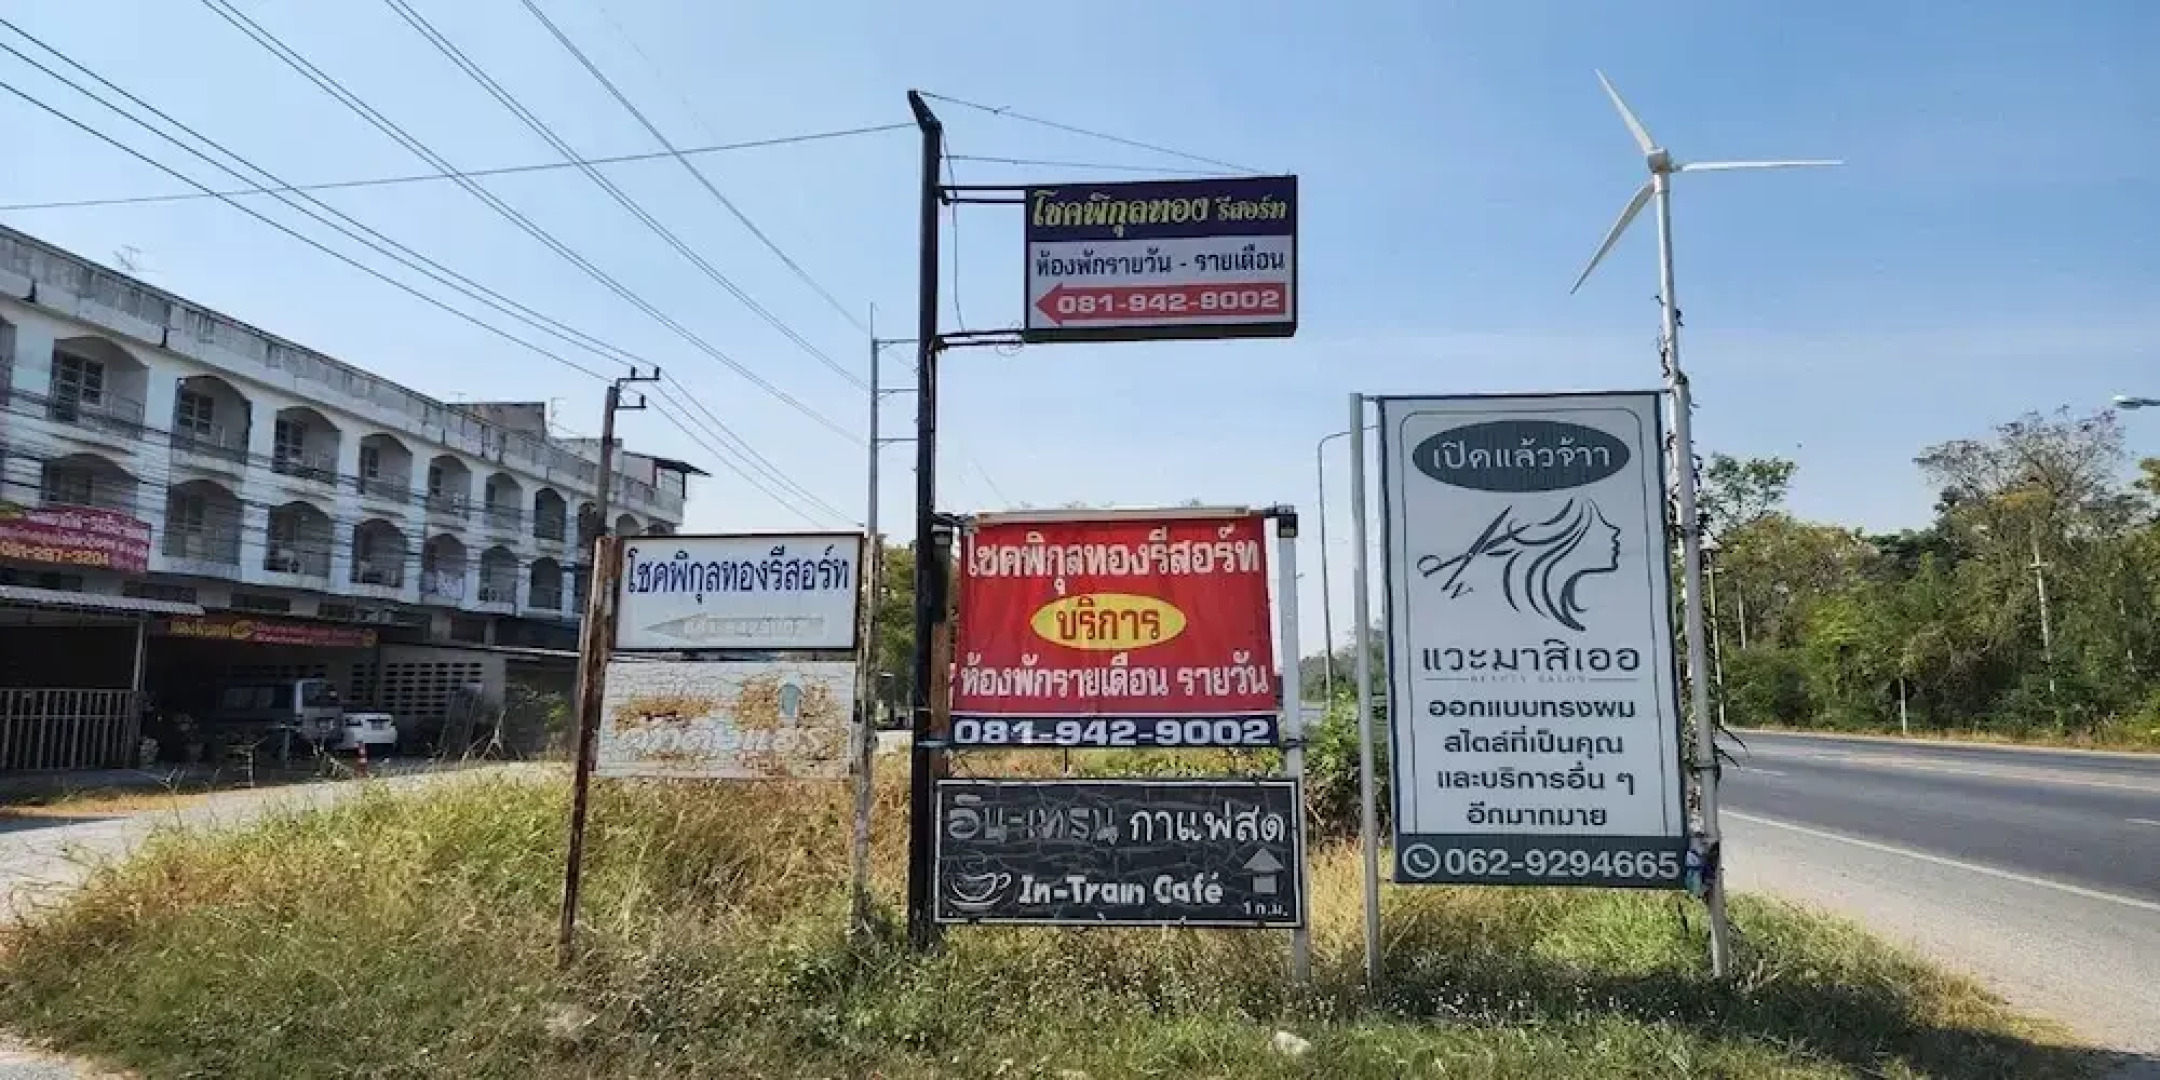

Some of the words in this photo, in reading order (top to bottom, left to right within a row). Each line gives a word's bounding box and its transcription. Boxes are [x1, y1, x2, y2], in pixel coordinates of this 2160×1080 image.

[1032, 189, 1211, 238] โชคพิกุลทอง
[1216, 194, 1287, 222] รีสอร์ท
[1036, 247, 1172, 277] ห้องพักรายวัน
[1193, 243, 1286, 272] รายเดือน
[1056, 290, 1281, 314] 081-942-9002
[1432, 436, 1611, 470] เปิดแล้วจ้าา
[627, 544, 850, 605] โชคพิกุลทองรีสอร์ท
[966, 526, 1261, 594] โชคพิกุลทองรีสอร์ท
[1056, 597, 1162, 641] บริการ
[1422, 638, 1641, 673] แวะมาสิเออ
[960, 651, 1169, 698] ห้องพักรายเดือน
[1176, 651, 1270, 697] รายวัน
[1429, 697, 1637, 719] ออกแบบทรงผม
[953, 718, 1272, 746] 081-942-9002
[1443, 726, 1625, 760] สไตล์ที่เป็นคุณ
[1437, 760, 1607, 790] และบริการอื่น
[1129, 800, 1286, 843] กาแฟสด
[1467, 801, 1608, 828] อีกมากมาย
[1444, 847, 1681, 880] 062-9294665
[1017, 874, 1146, 906] In-Train
[1152, 871, 1224, 906] Café
